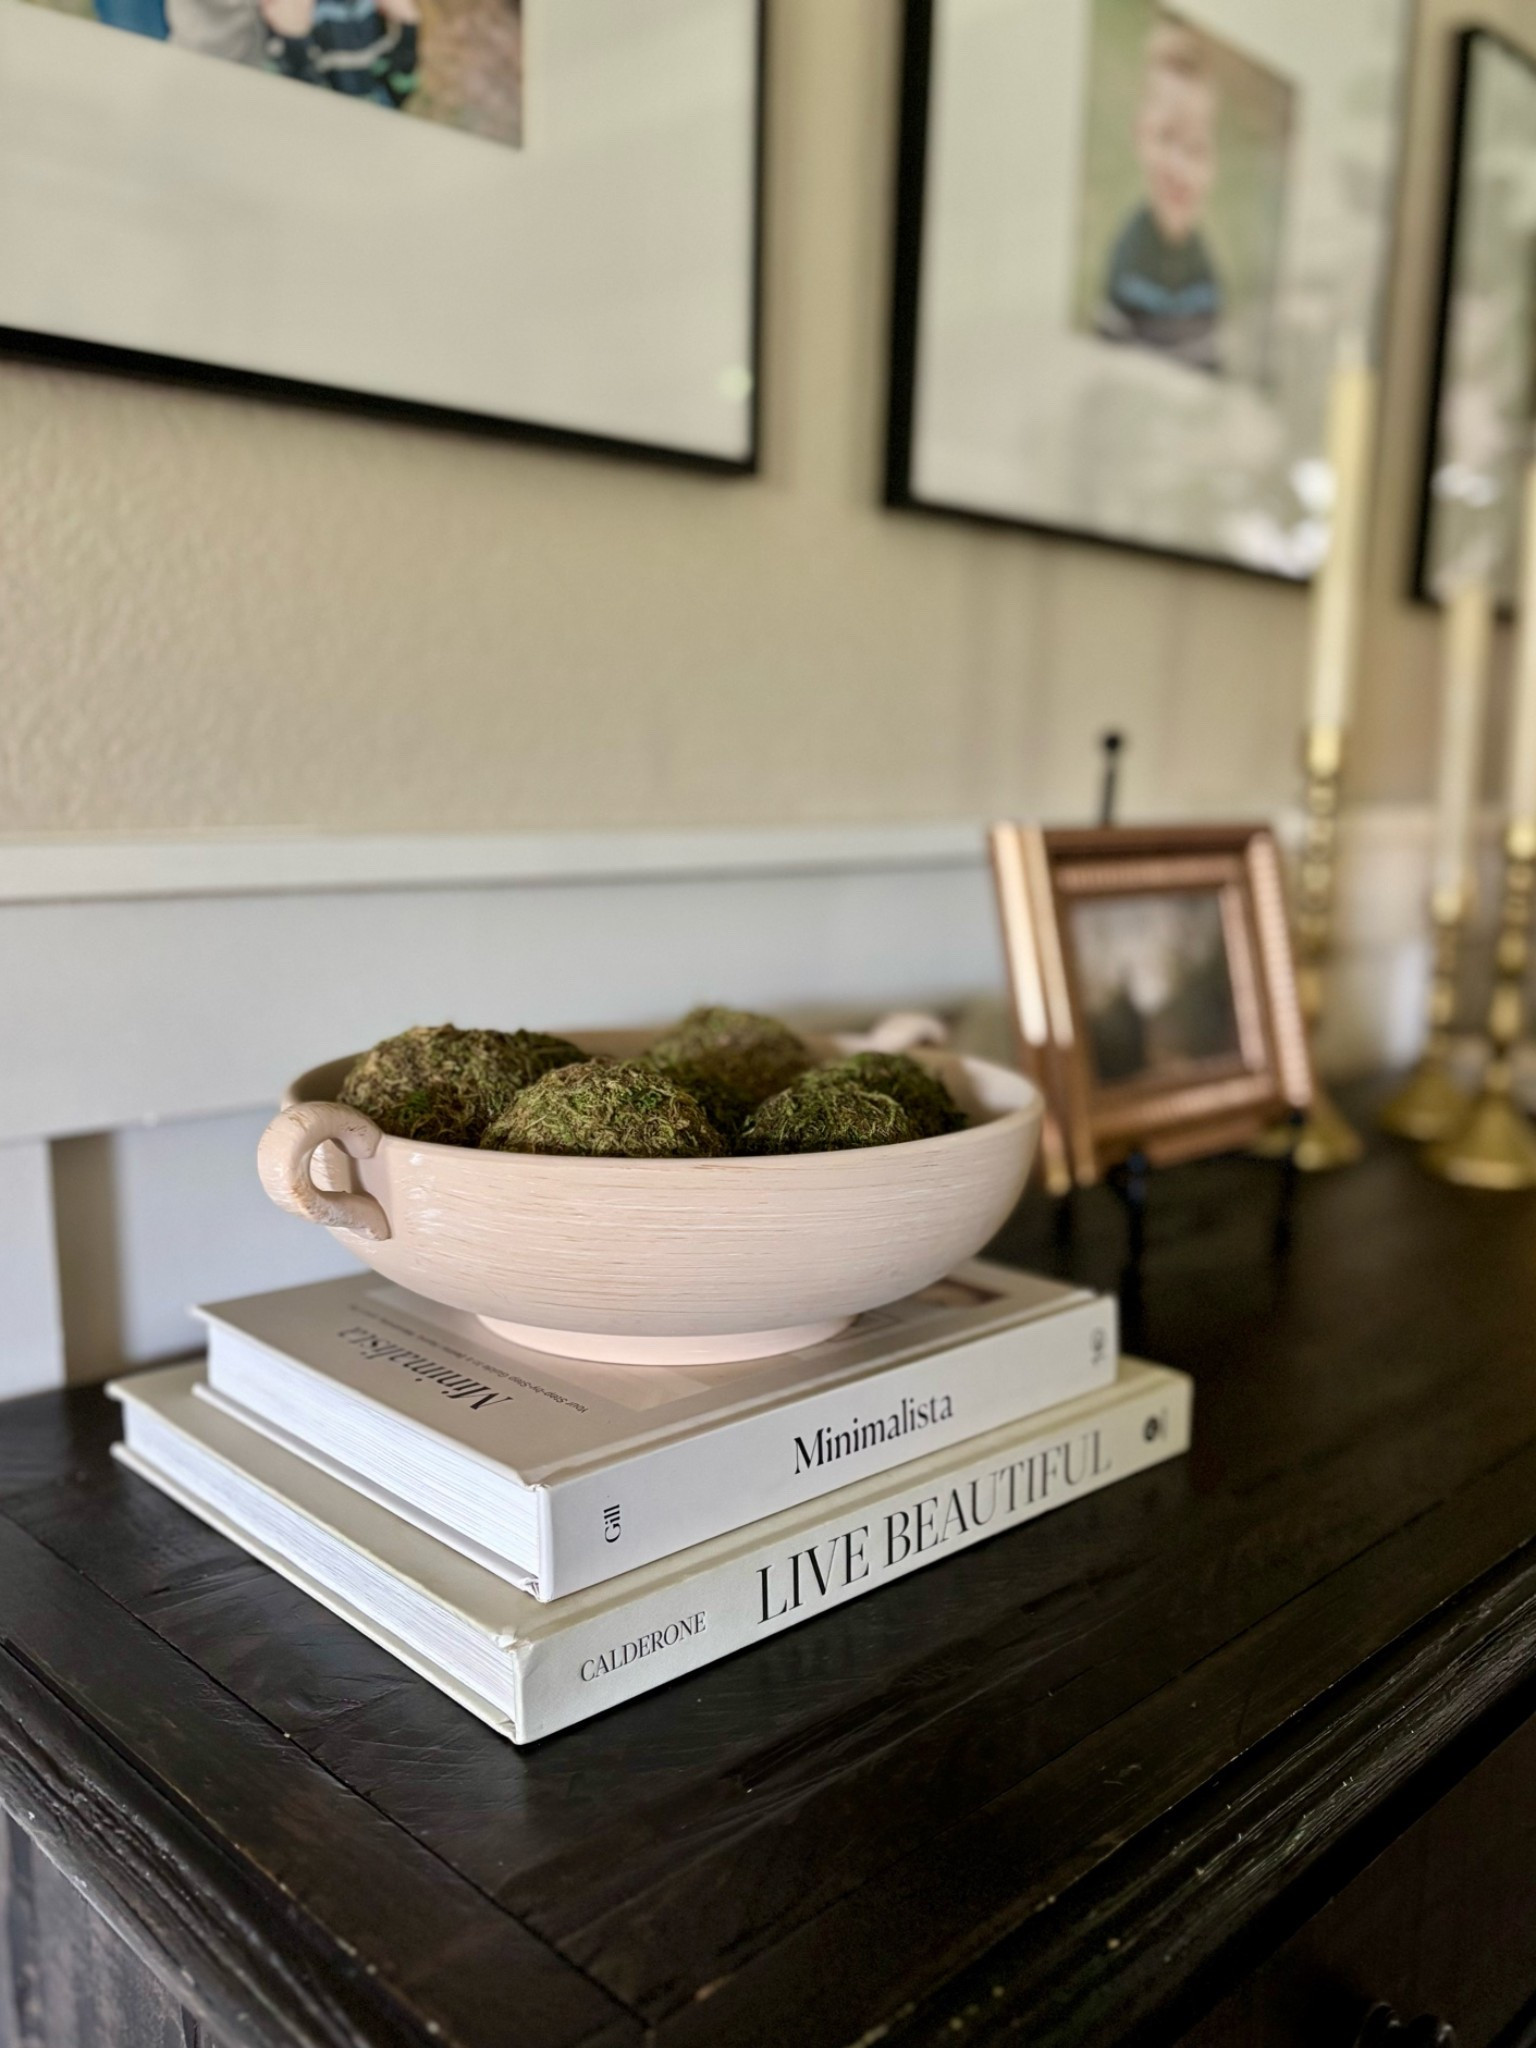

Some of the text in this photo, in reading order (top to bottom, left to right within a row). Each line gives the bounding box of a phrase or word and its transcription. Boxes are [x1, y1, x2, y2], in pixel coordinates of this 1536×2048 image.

[337, 1327, 513, 1410] Minimalista
[565, 1401, 589, 1414] Your
[794, 1395, 953, 1475] Minimalista
[603, 1504, 622, 1543] Gill
[757, 1430, 1112, 1624] LIVE BEAUTIFUL
[580, 1611, 707, 1683] CALDERONE
